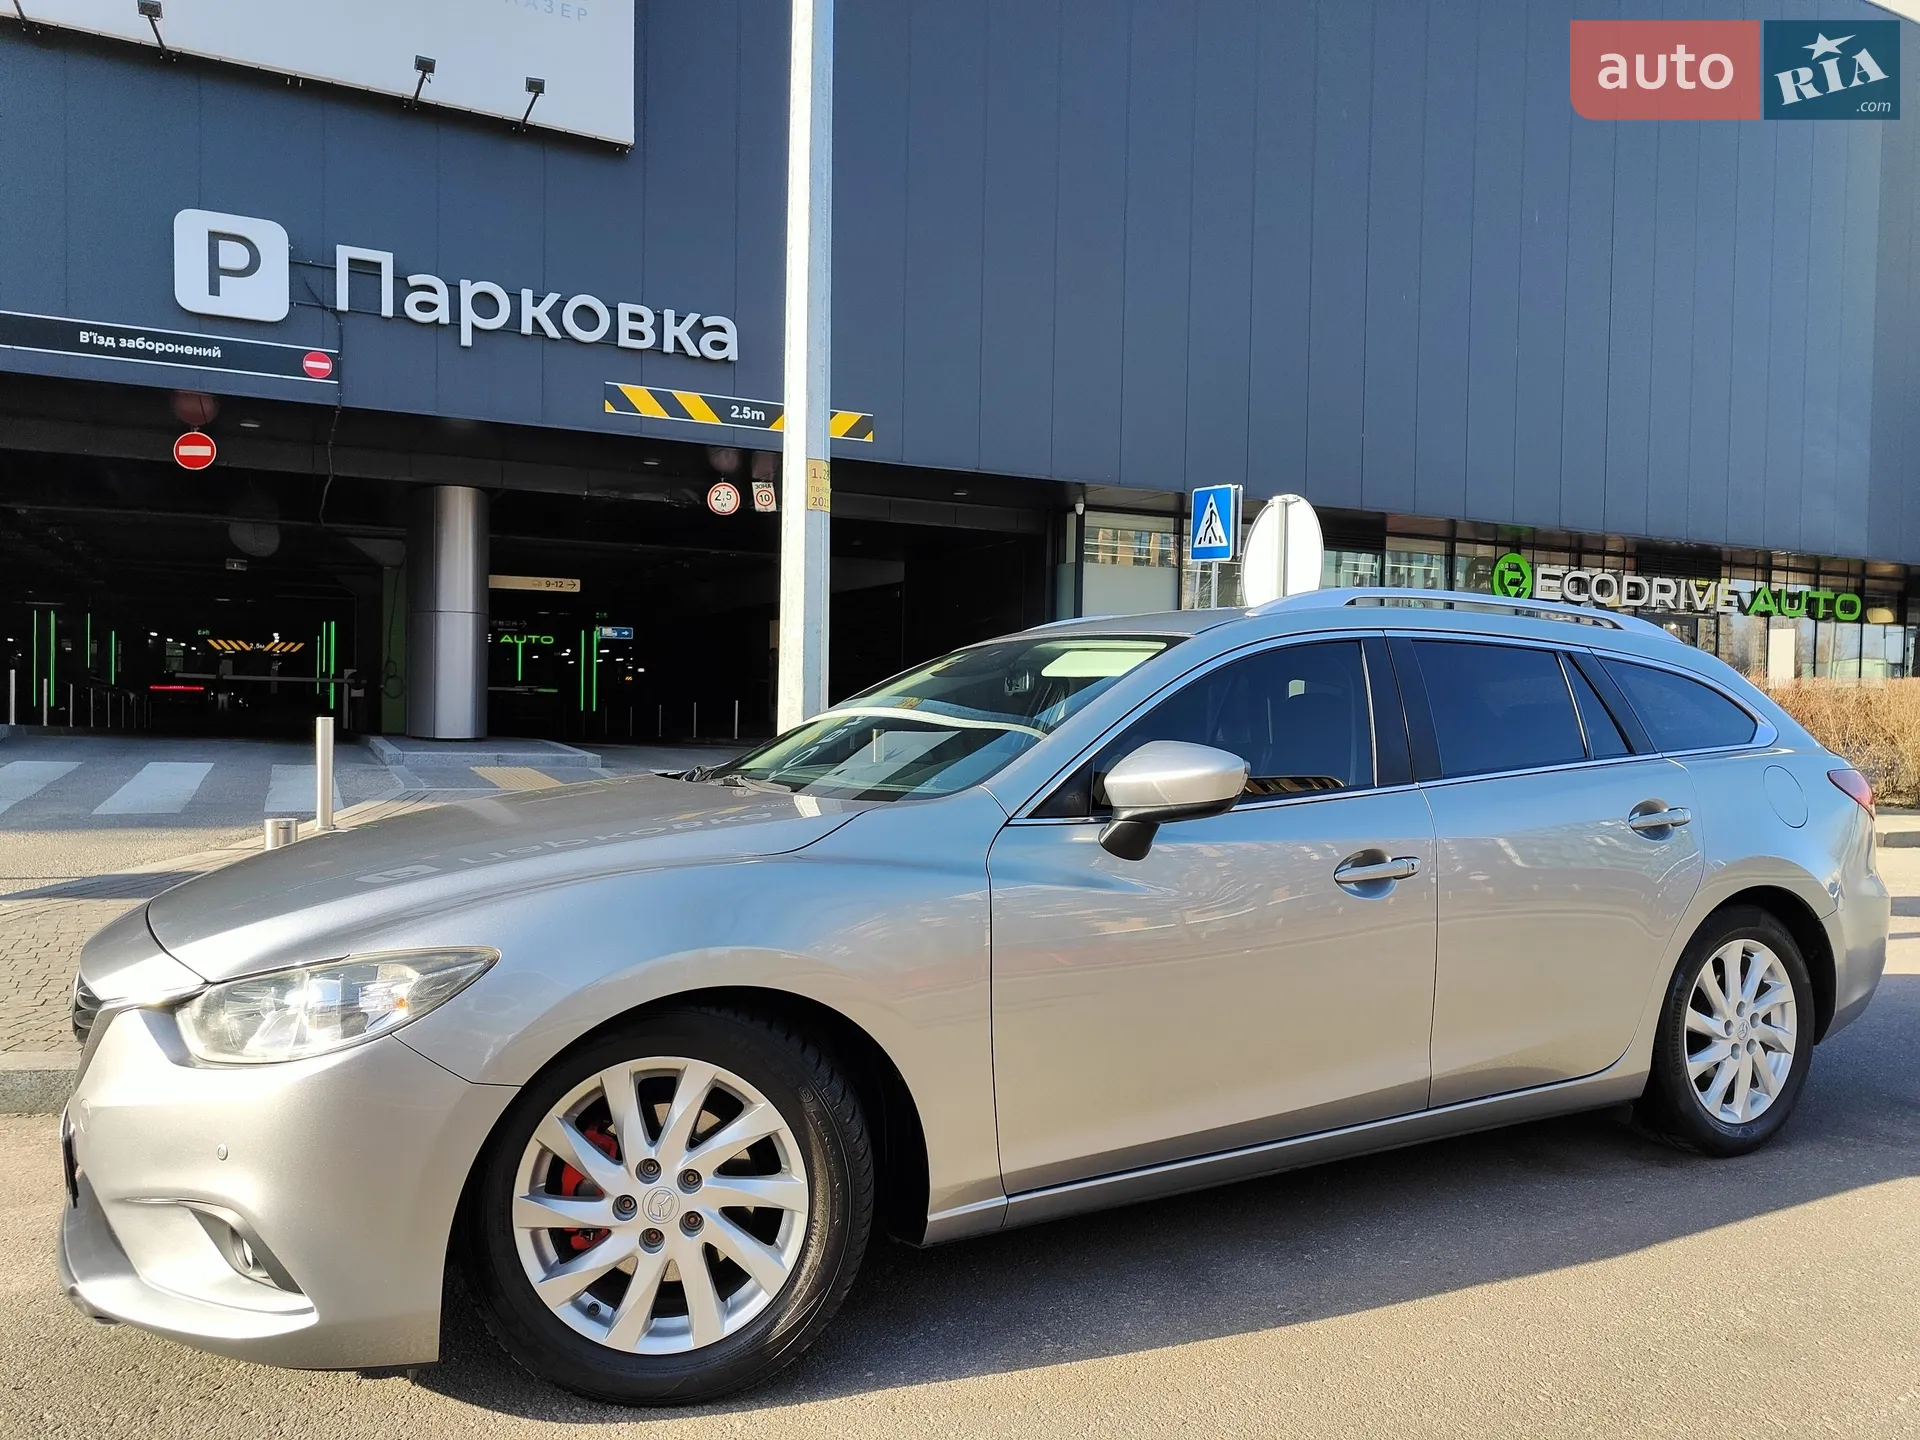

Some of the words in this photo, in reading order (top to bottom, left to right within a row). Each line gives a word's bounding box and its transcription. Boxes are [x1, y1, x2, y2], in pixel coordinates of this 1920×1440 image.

[504, 0, 588, 21] АЗЕР
[335, 243, 739, 362] Парковка
[78, 330, 116, 348] В'їзд
[118, 337, 222, 358] заборонений
[730, 404, 766, 421] 2.5m
[714, 489, 732, 502] 2,5
[759, 494, 771, 503] 10
[545, 580, 564, 588] 9-12
[1535, 566, 1739, 613] ECODRIVE
[1748, 586, 1862, 622] AUTO
[500, 634, 554, 645] AUTO
